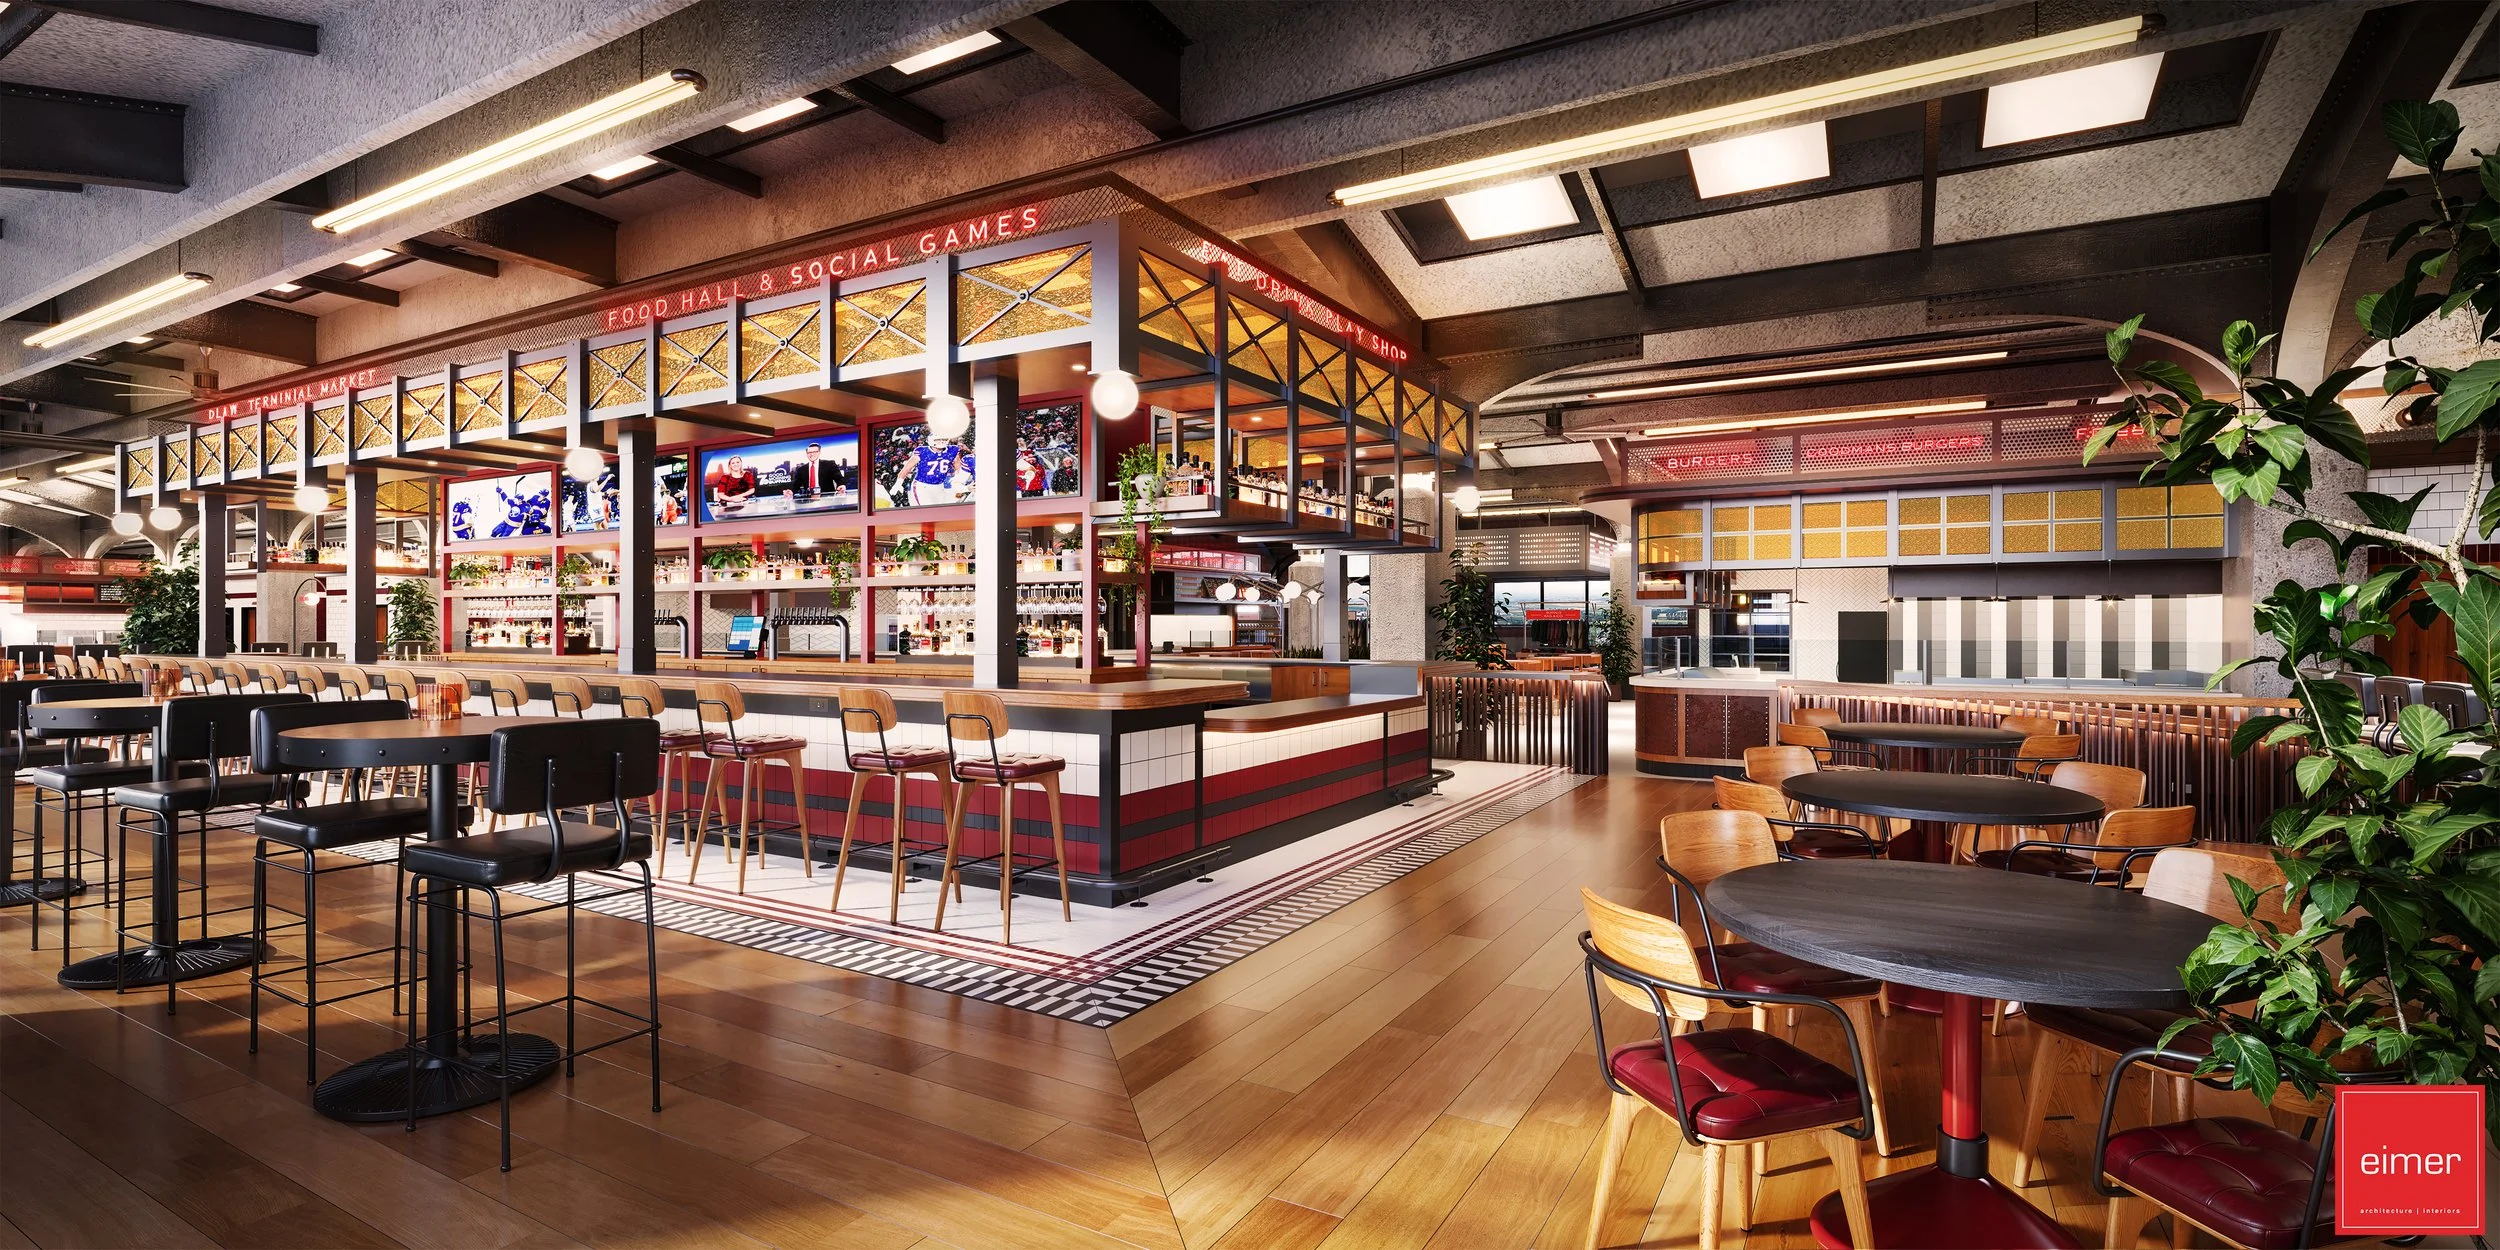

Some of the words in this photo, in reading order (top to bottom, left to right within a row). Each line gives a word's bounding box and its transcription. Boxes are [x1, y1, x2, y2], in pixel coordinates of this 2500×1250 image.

[608, 297, 668, 327] FOOD
[682, 281, 745, 308] HALL
[760, 274, 773, 292] &
[790, 243, 900, 286] SOCIAL
[920, 207, 1039, 255] GAMES
[1325, 309, 1364, 342] PLAY
[1372, 334, 1407, 360] SHOP
[248, 386, 313, 411] TERMINIAL
[320, 369, 377, 396] MARKET
[1667, 453, 1753, 469] BURGERS
[1806, 443, 1896, 458] GOODMANS
[1902, 436, 1982, 451] BURGERS
[926, 459, 950, 476] 76
